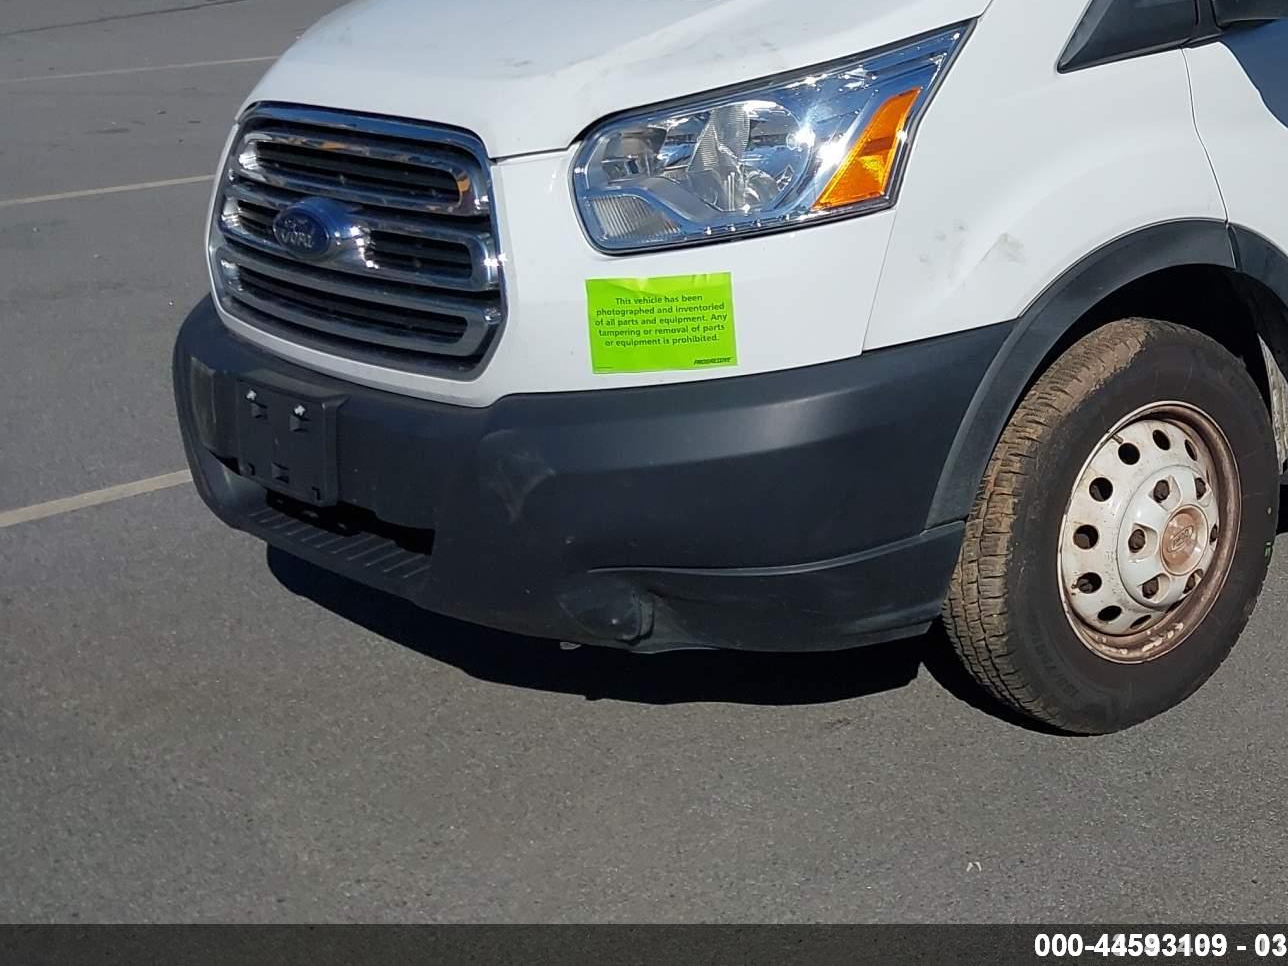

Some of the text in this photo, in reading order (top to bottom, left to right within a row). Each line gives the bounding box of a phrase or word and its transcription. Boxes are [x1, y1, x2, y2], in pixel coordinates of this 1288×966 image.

[634, 296, 662, 304] vehicle
[665, 295, 679, 303] has
[682, 294, 703, 302] been
[596, 302, 725, 317] photographed and inventoried
[595, 318, 605, 326] of
[606, 318, 615, 326] all
[618, 318, 638, 328] parts
[641, 317, 656, 325] and
[710, 314, 728, 324] Any
[599, 328, 641, 338] tampering
[655, 325, 689, 334] removal
[691, 324, 700, 333] of
[703, 323, 725, 334] parts
[616, 337, 661, 348] equipment
[672, 333, 720, 346] prohibited.
